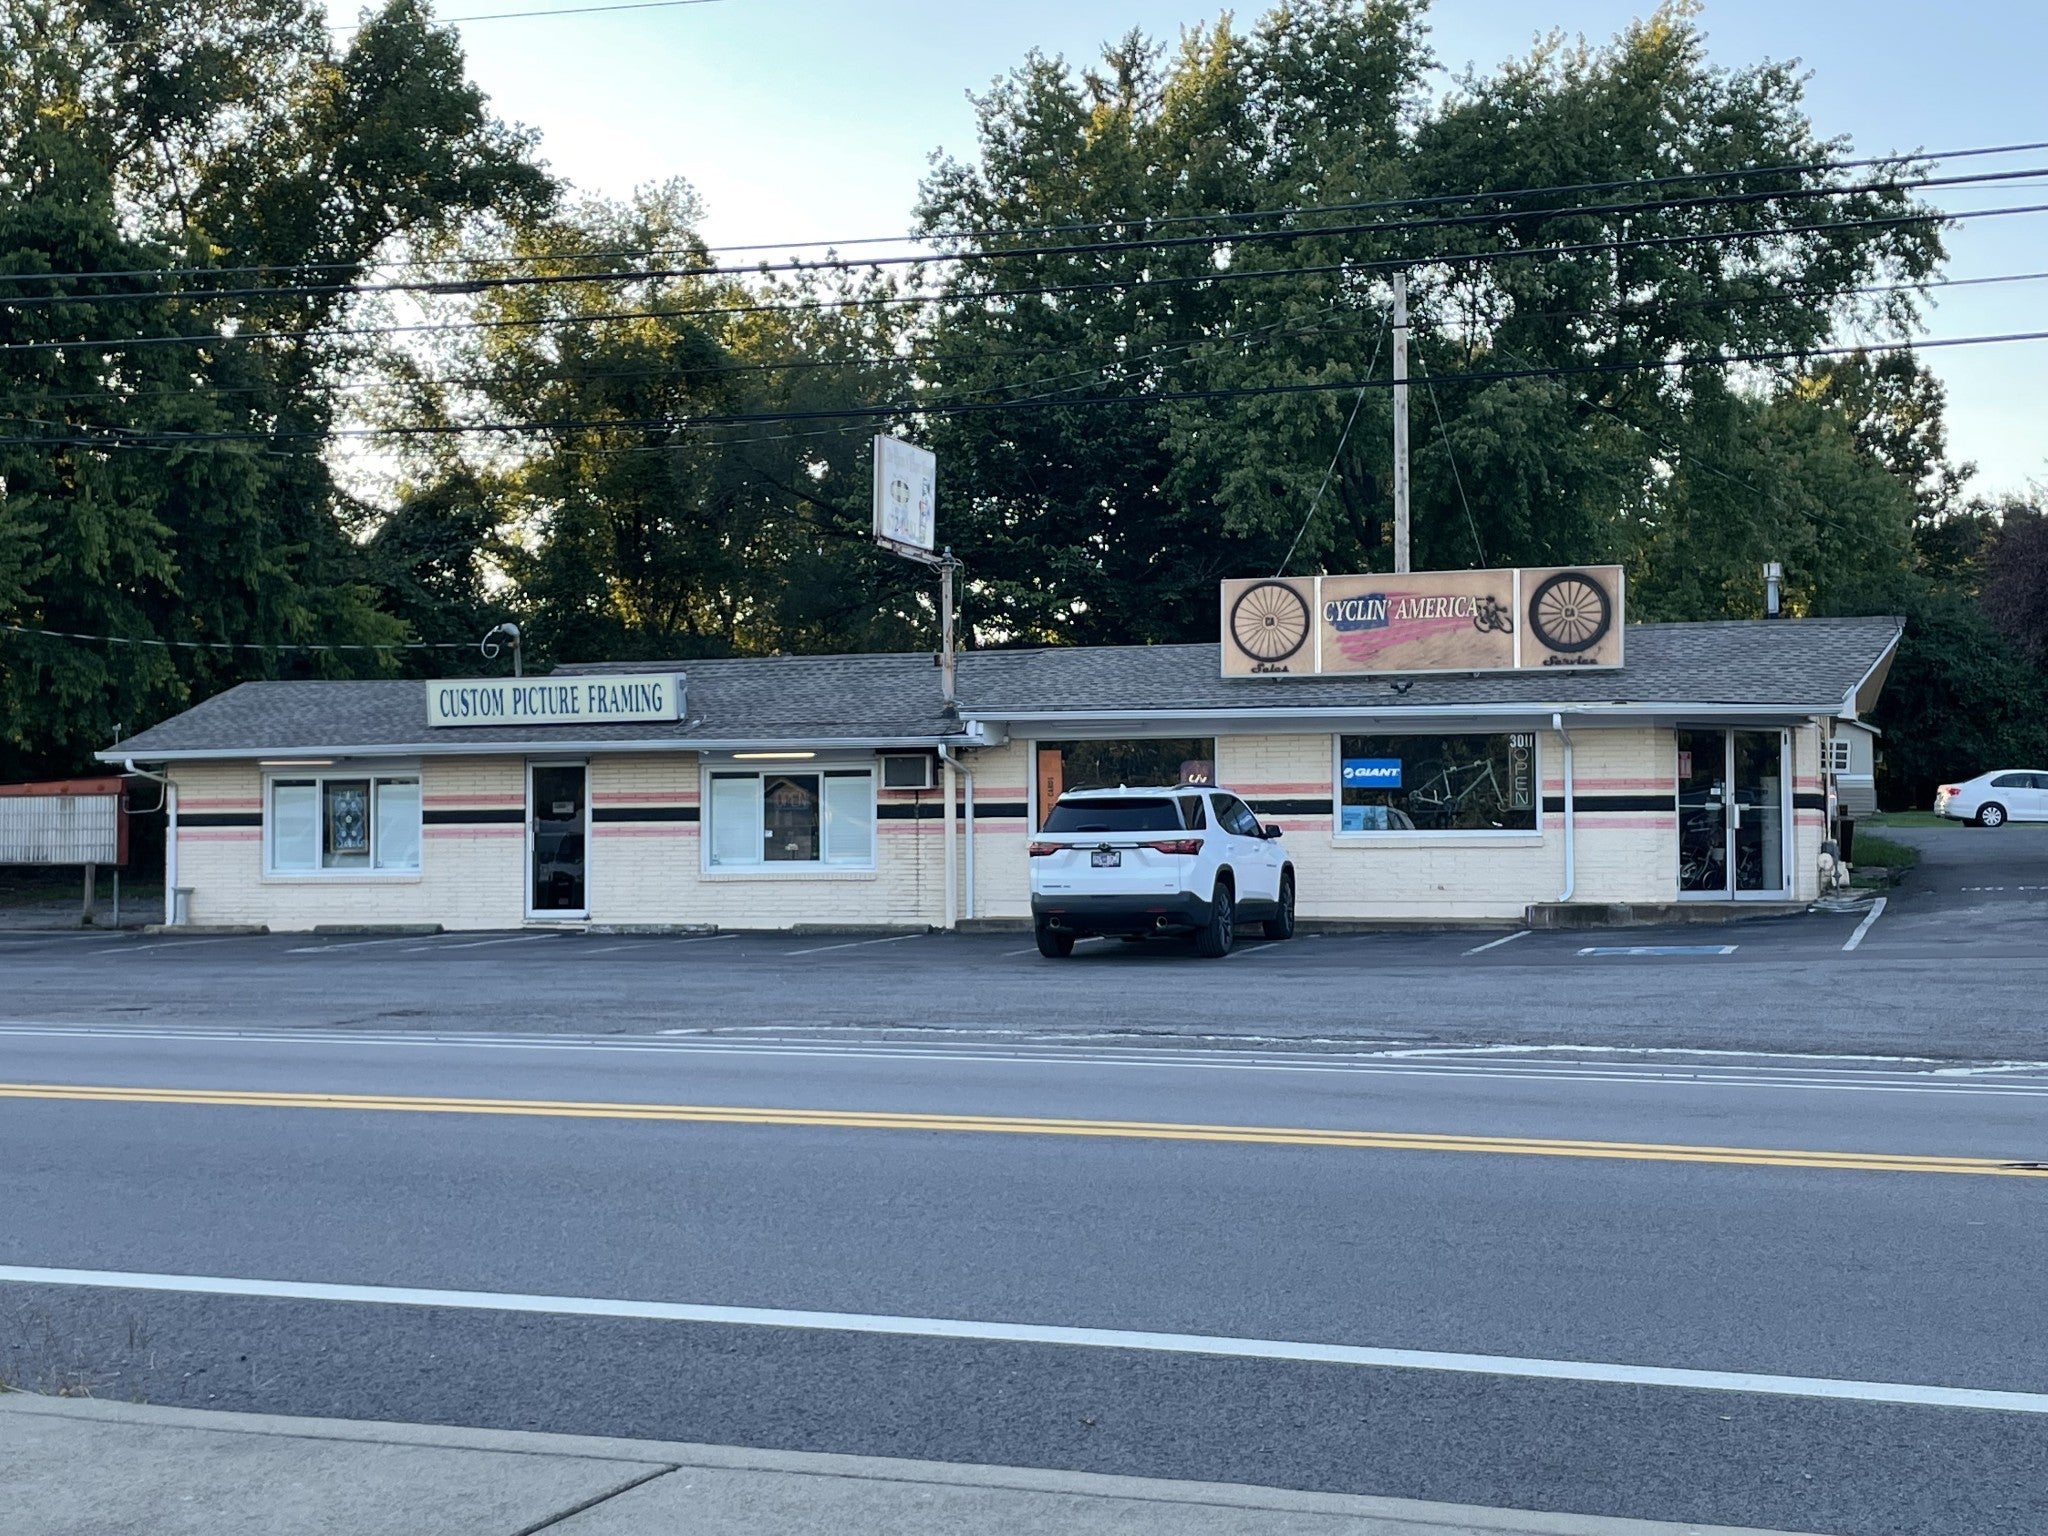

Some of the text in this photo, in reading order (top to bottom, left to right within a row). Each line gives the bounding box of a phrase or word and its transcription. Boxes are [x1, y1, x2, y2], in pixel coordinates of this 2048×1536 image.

[1323, 596, 1479, 622] CYCLIN' AMERICA
[1564, 608, 1575, 618] CA
[1543, 655, 1598, 666] Service
[1251, 662, 1290, 674] Sales
[440, 682, 663, 718] CUSTOM PICTURE FRAMING
[1509, 733, 1533, 748] 3011
[1355, 767, 1400, 777] GIANT
[1513, 748, 1529, 805] OPEN
